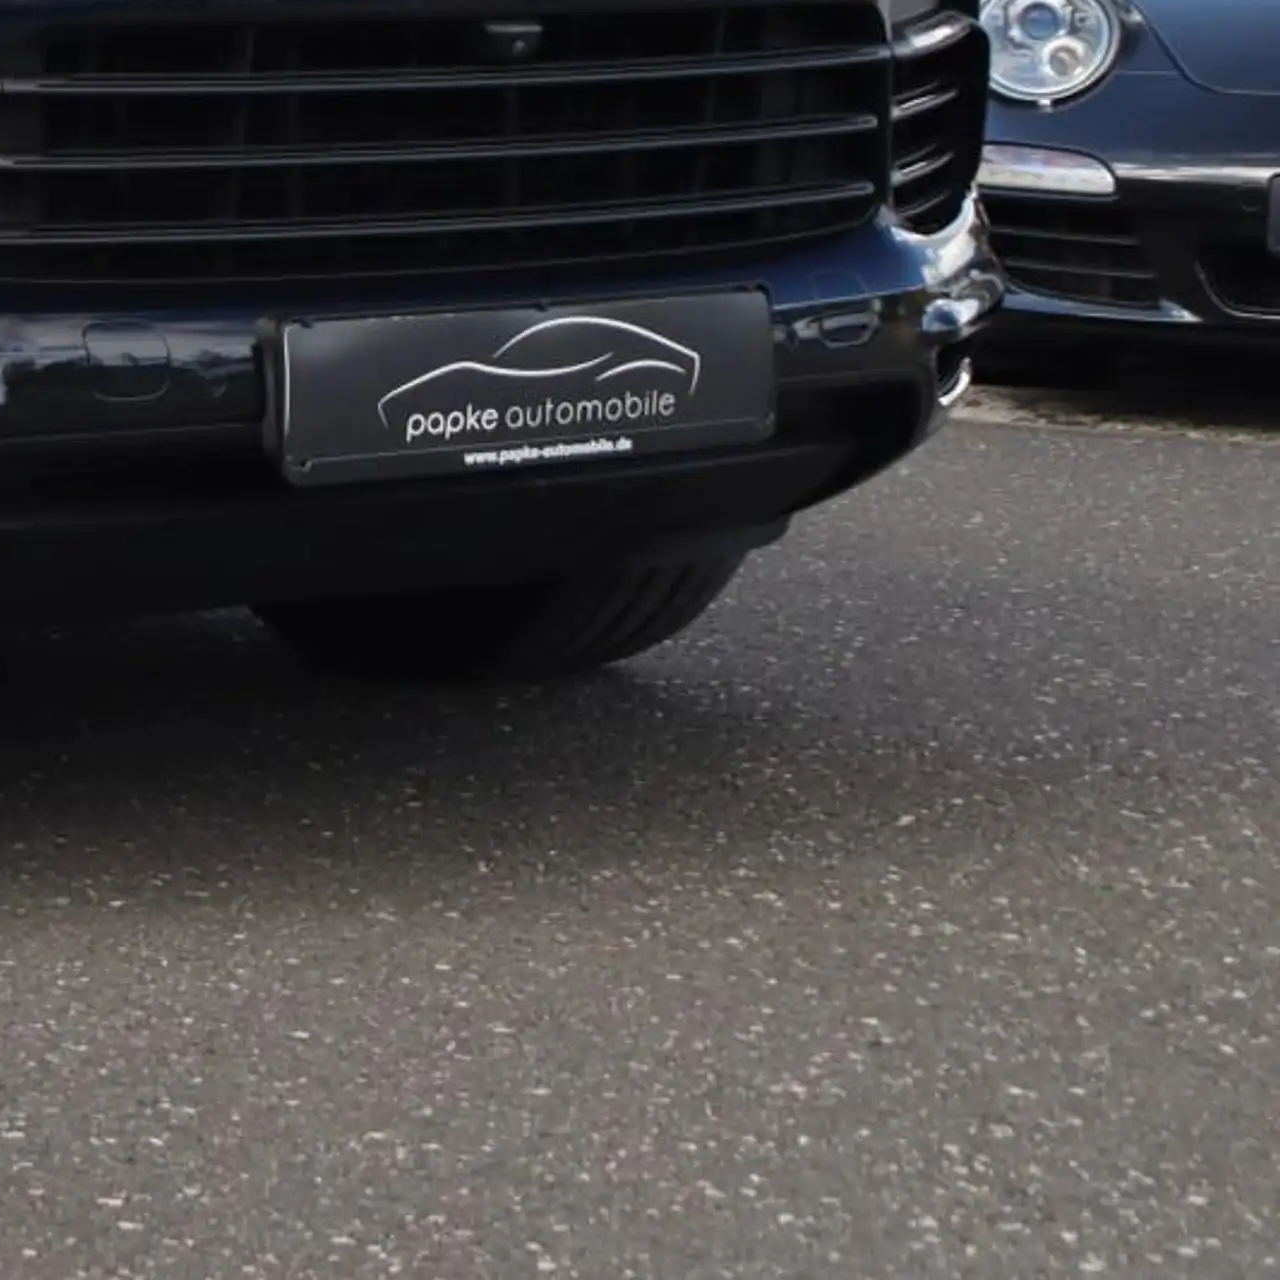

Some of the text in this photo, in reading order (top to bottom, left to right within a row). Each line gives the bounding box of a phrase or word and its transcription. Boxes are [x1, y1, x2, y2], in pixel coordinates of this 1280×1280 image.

[406, 389, 676, 443] papke automobile
[463, 436, 634, 466] www.papke-automobile.de
